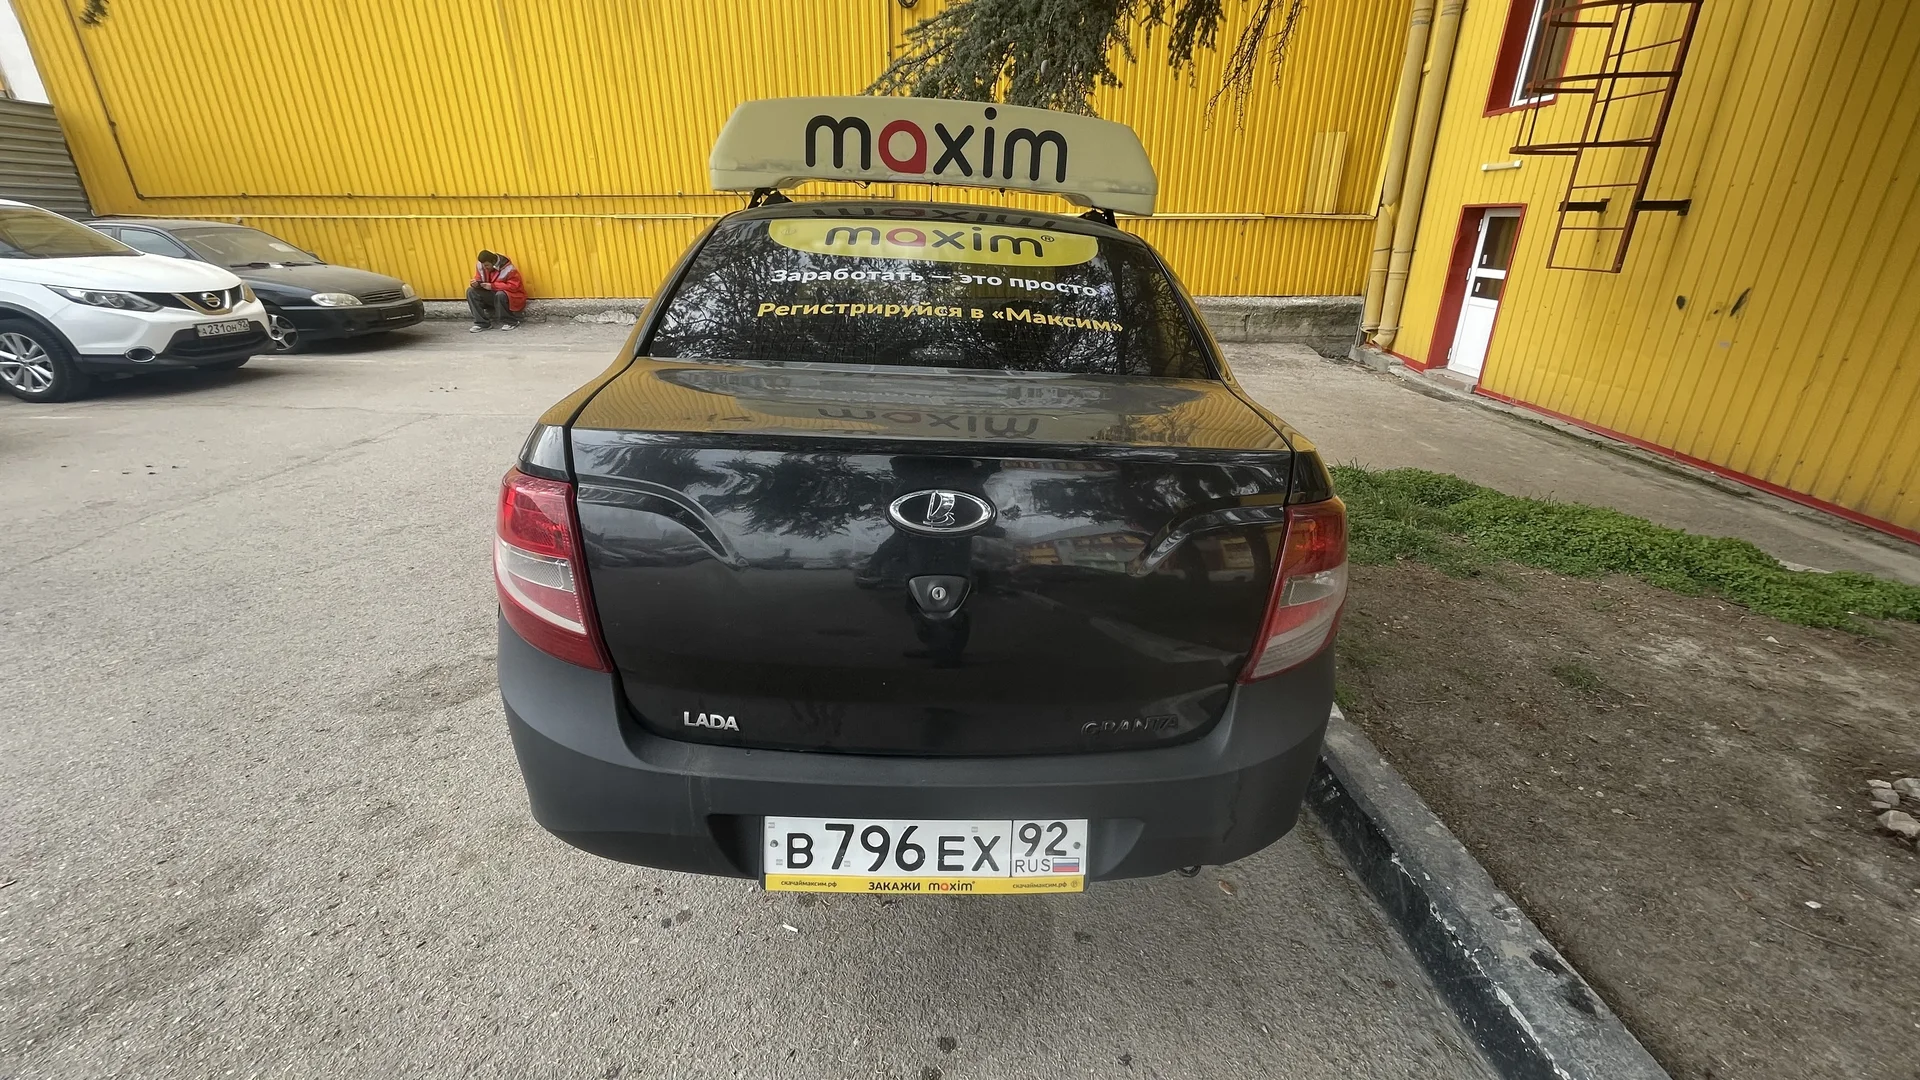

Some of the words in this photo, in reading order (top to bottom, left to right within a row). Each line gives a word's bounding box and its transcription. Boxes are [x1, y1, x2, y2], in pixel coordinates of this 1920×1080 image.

[805, 106, 1068, 183] maxim
[771, 268, 924, 284] Заработать
[959, 274, 1003, 286] это
[1009, 276, 1098, 297] просто
[756, 301, 963, 318] Регистрируйся
[970, 308, 985, 320] в
[991, 307, 1124, 332] «Максим»
[683, 711, 740, 731] LADA
[1018, 821, 1068, 857] 92
[1015, 858, 1051, 873] RUS
[868, 881, 921, 891] ЗАКАЖИ
